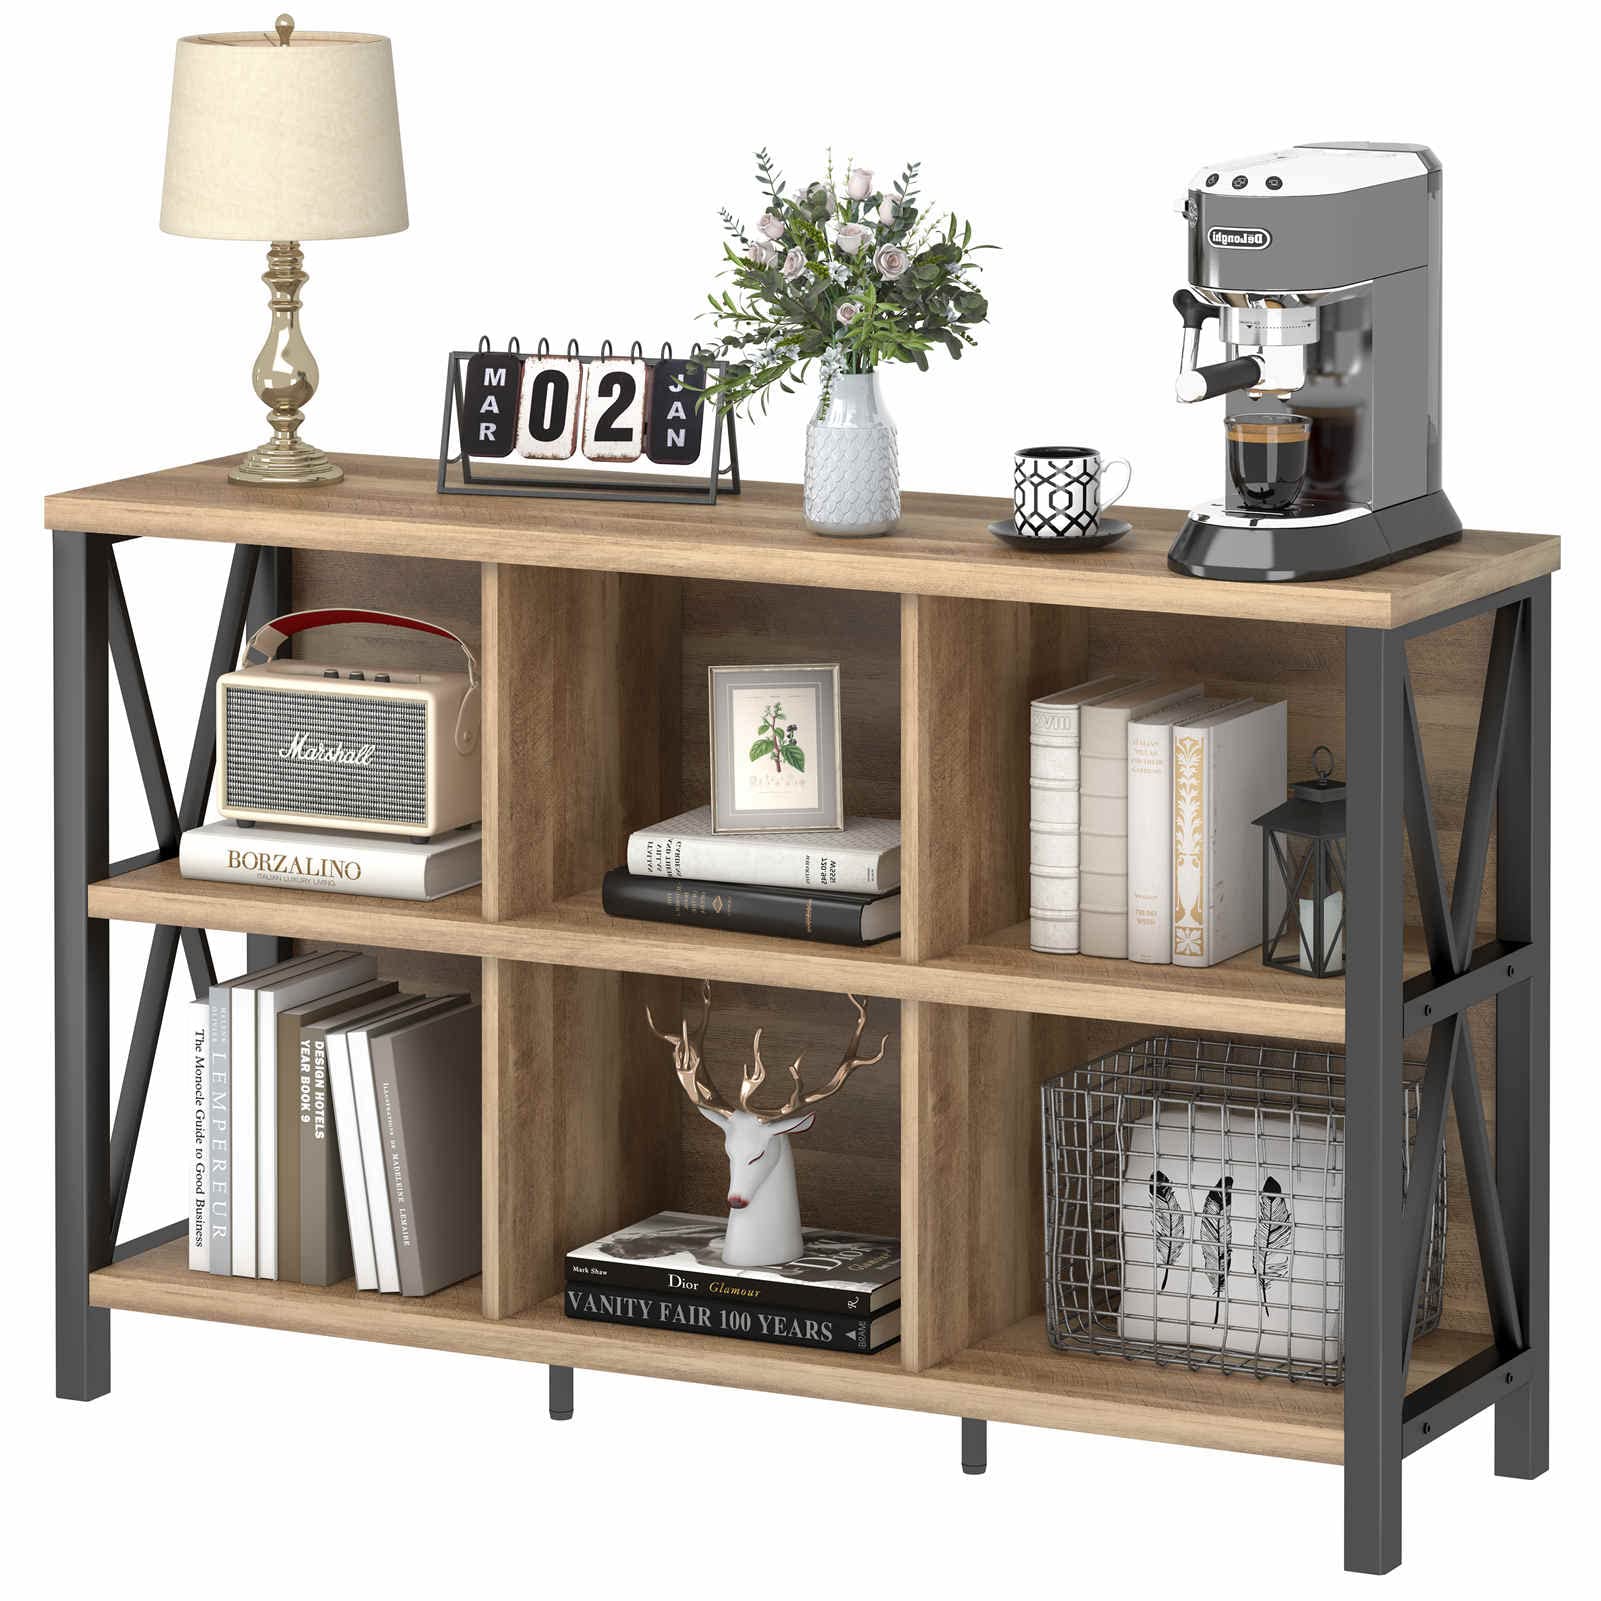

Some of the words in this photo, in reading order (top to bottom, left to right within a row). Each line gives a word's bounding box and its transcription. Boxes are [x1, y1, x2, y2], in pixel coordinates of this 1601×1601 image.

[478, 368, 506, 441] MAR
[666, 373, 687, 448] JAN
[279, 732, 376, 765] Marshall
[226, 850, 362, 880] BORZALINO
[195, 1029, 205, 1052] The
[301, 1040, 311, 1073] YEAR
[195, 1055, 205, 1106] Monocle
[315, 1041, 325, 1088] DESIGN
[301, 1076, 311, 1111] BOOK
[195, 1109, 205, 1144] Guide
[301, 1114, 311, 1123] 9
[315, 1092, 325, 1139] HOTELS
[195, 1148, 203, 1159] to
[212, 1053, 227, 1240] LEMPEREUR
[195, 1162, 205, 1194] Good
[195, 1199, 205, 1248] Business
[399, 1208, 411, 1247] LEMAIRE
[572, 1264, 589, 1274] Mark
[590, 1267, 608, 1276] Shaw
[668, 1273, 699, 1290] Dior
[708, 1281, 761, 1298] Glamour
[567, 1290, 653, 1320] VANITY
[659, 1302, 712, 1327] FAIR
[719, 1309, 751, 1333] 100
[758, 1313, 833, 1343] YEARS
